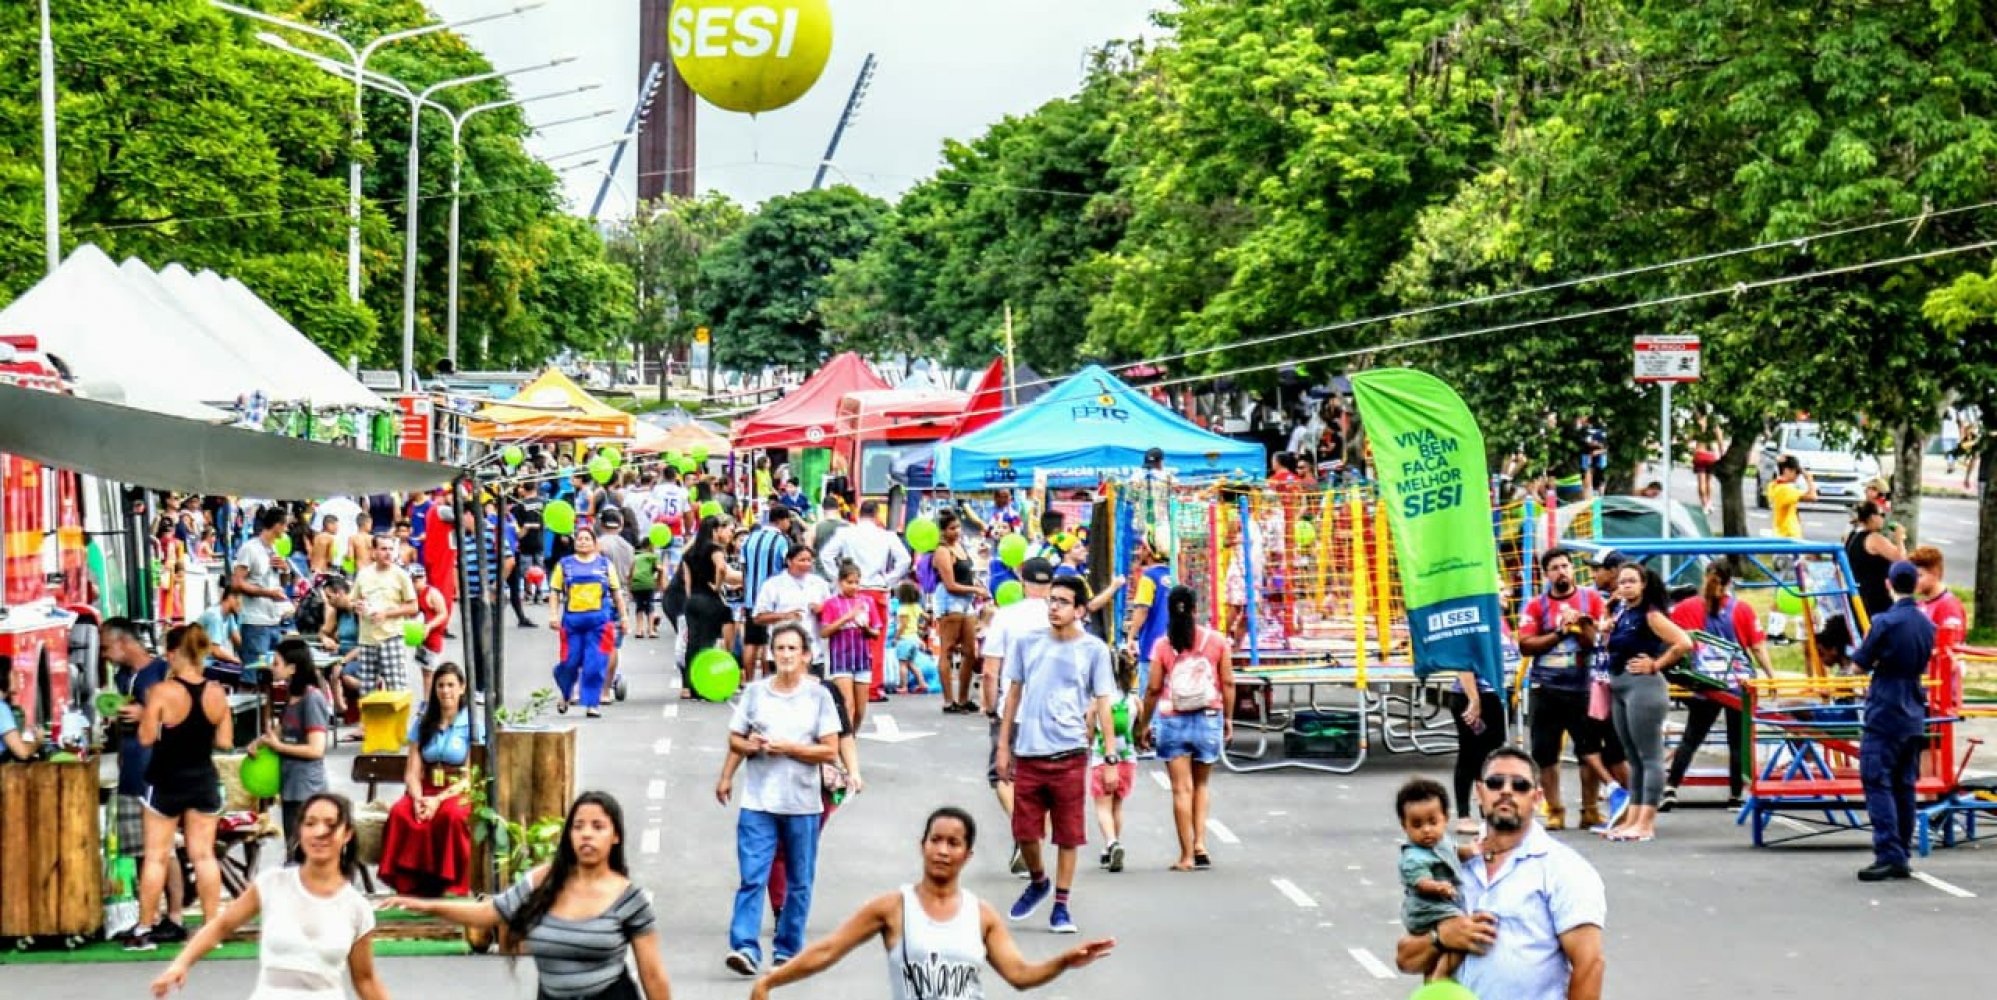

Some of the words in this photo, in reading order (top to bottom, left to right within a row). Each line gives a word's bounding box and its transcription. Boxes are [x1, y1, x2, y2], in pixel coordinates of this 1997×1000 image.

[671, 7, 800, 58] SESI
[1394, 428, 1437, 449] VIVA
[1420, 437, 1458, 457] BEM
[1397, 467, 1462, 496] MELHOR
[664, 498, 677, 516] 15
[1403, 484, 1463, 518] SESI
